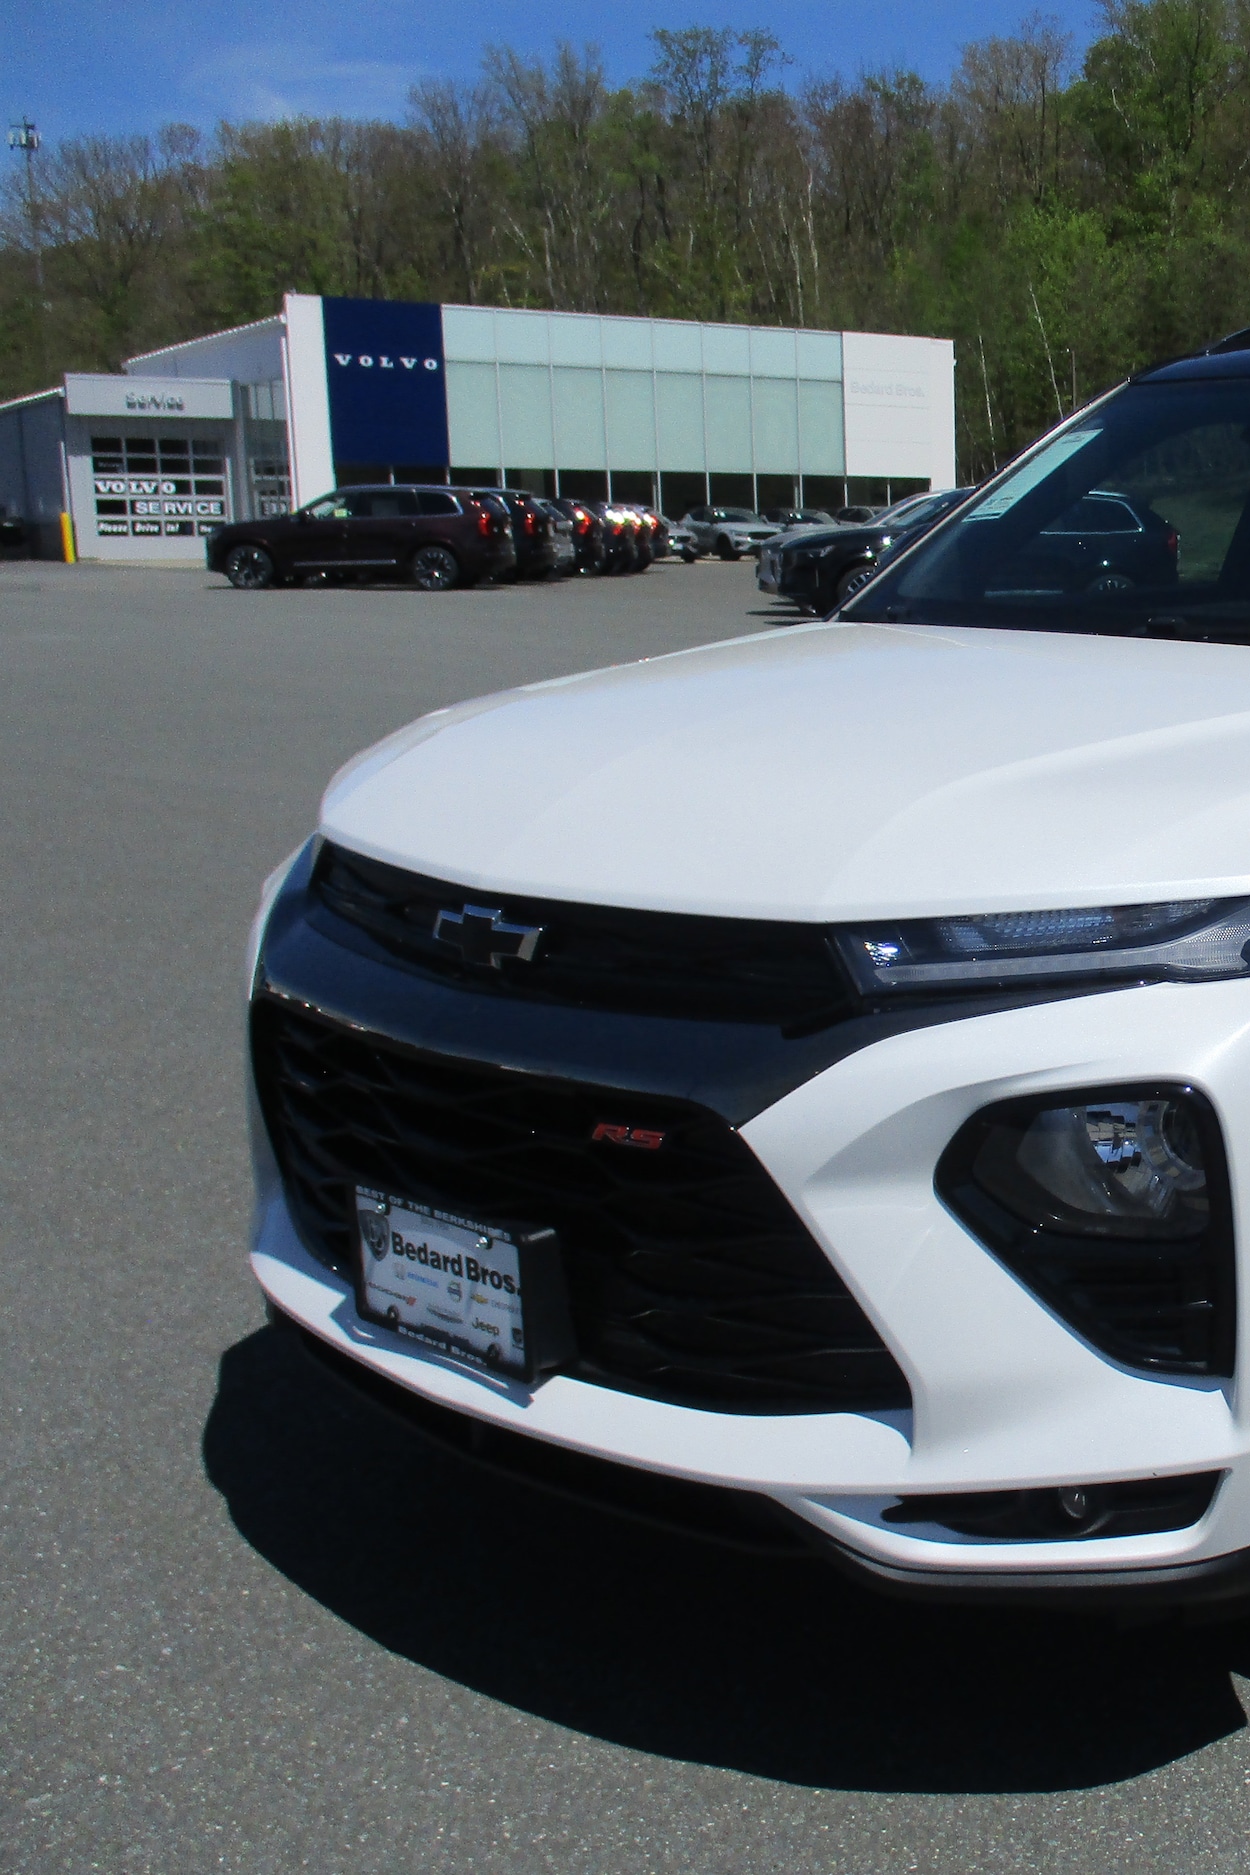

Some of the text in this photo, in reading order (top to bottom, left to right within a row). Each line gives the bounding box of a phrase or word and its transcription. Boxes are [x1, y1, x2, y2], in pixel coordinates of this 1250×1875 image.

[333, 353, 438, 371] VOLVO
[126, 392, 184, 411] Service
[95, 480, 176, 494] VOLVO
[135, 501, 221, 515] SERVICE
[592, 1123, 666, 1149] RS
[355, 1185, 385, 1201] BEST
[388, 1195, 404, 1206] OF
[407, 1200, 431, 1215] THE
[433, 1209, 512, 1243] BERKSHIRES
[391, 1231, 464, 1278] Bedard
[465, 1256, 521, 1296] Bros.
[472, 1317, 500, 1337] Jeep
[398, 1325, 448, 1350] Bedard
